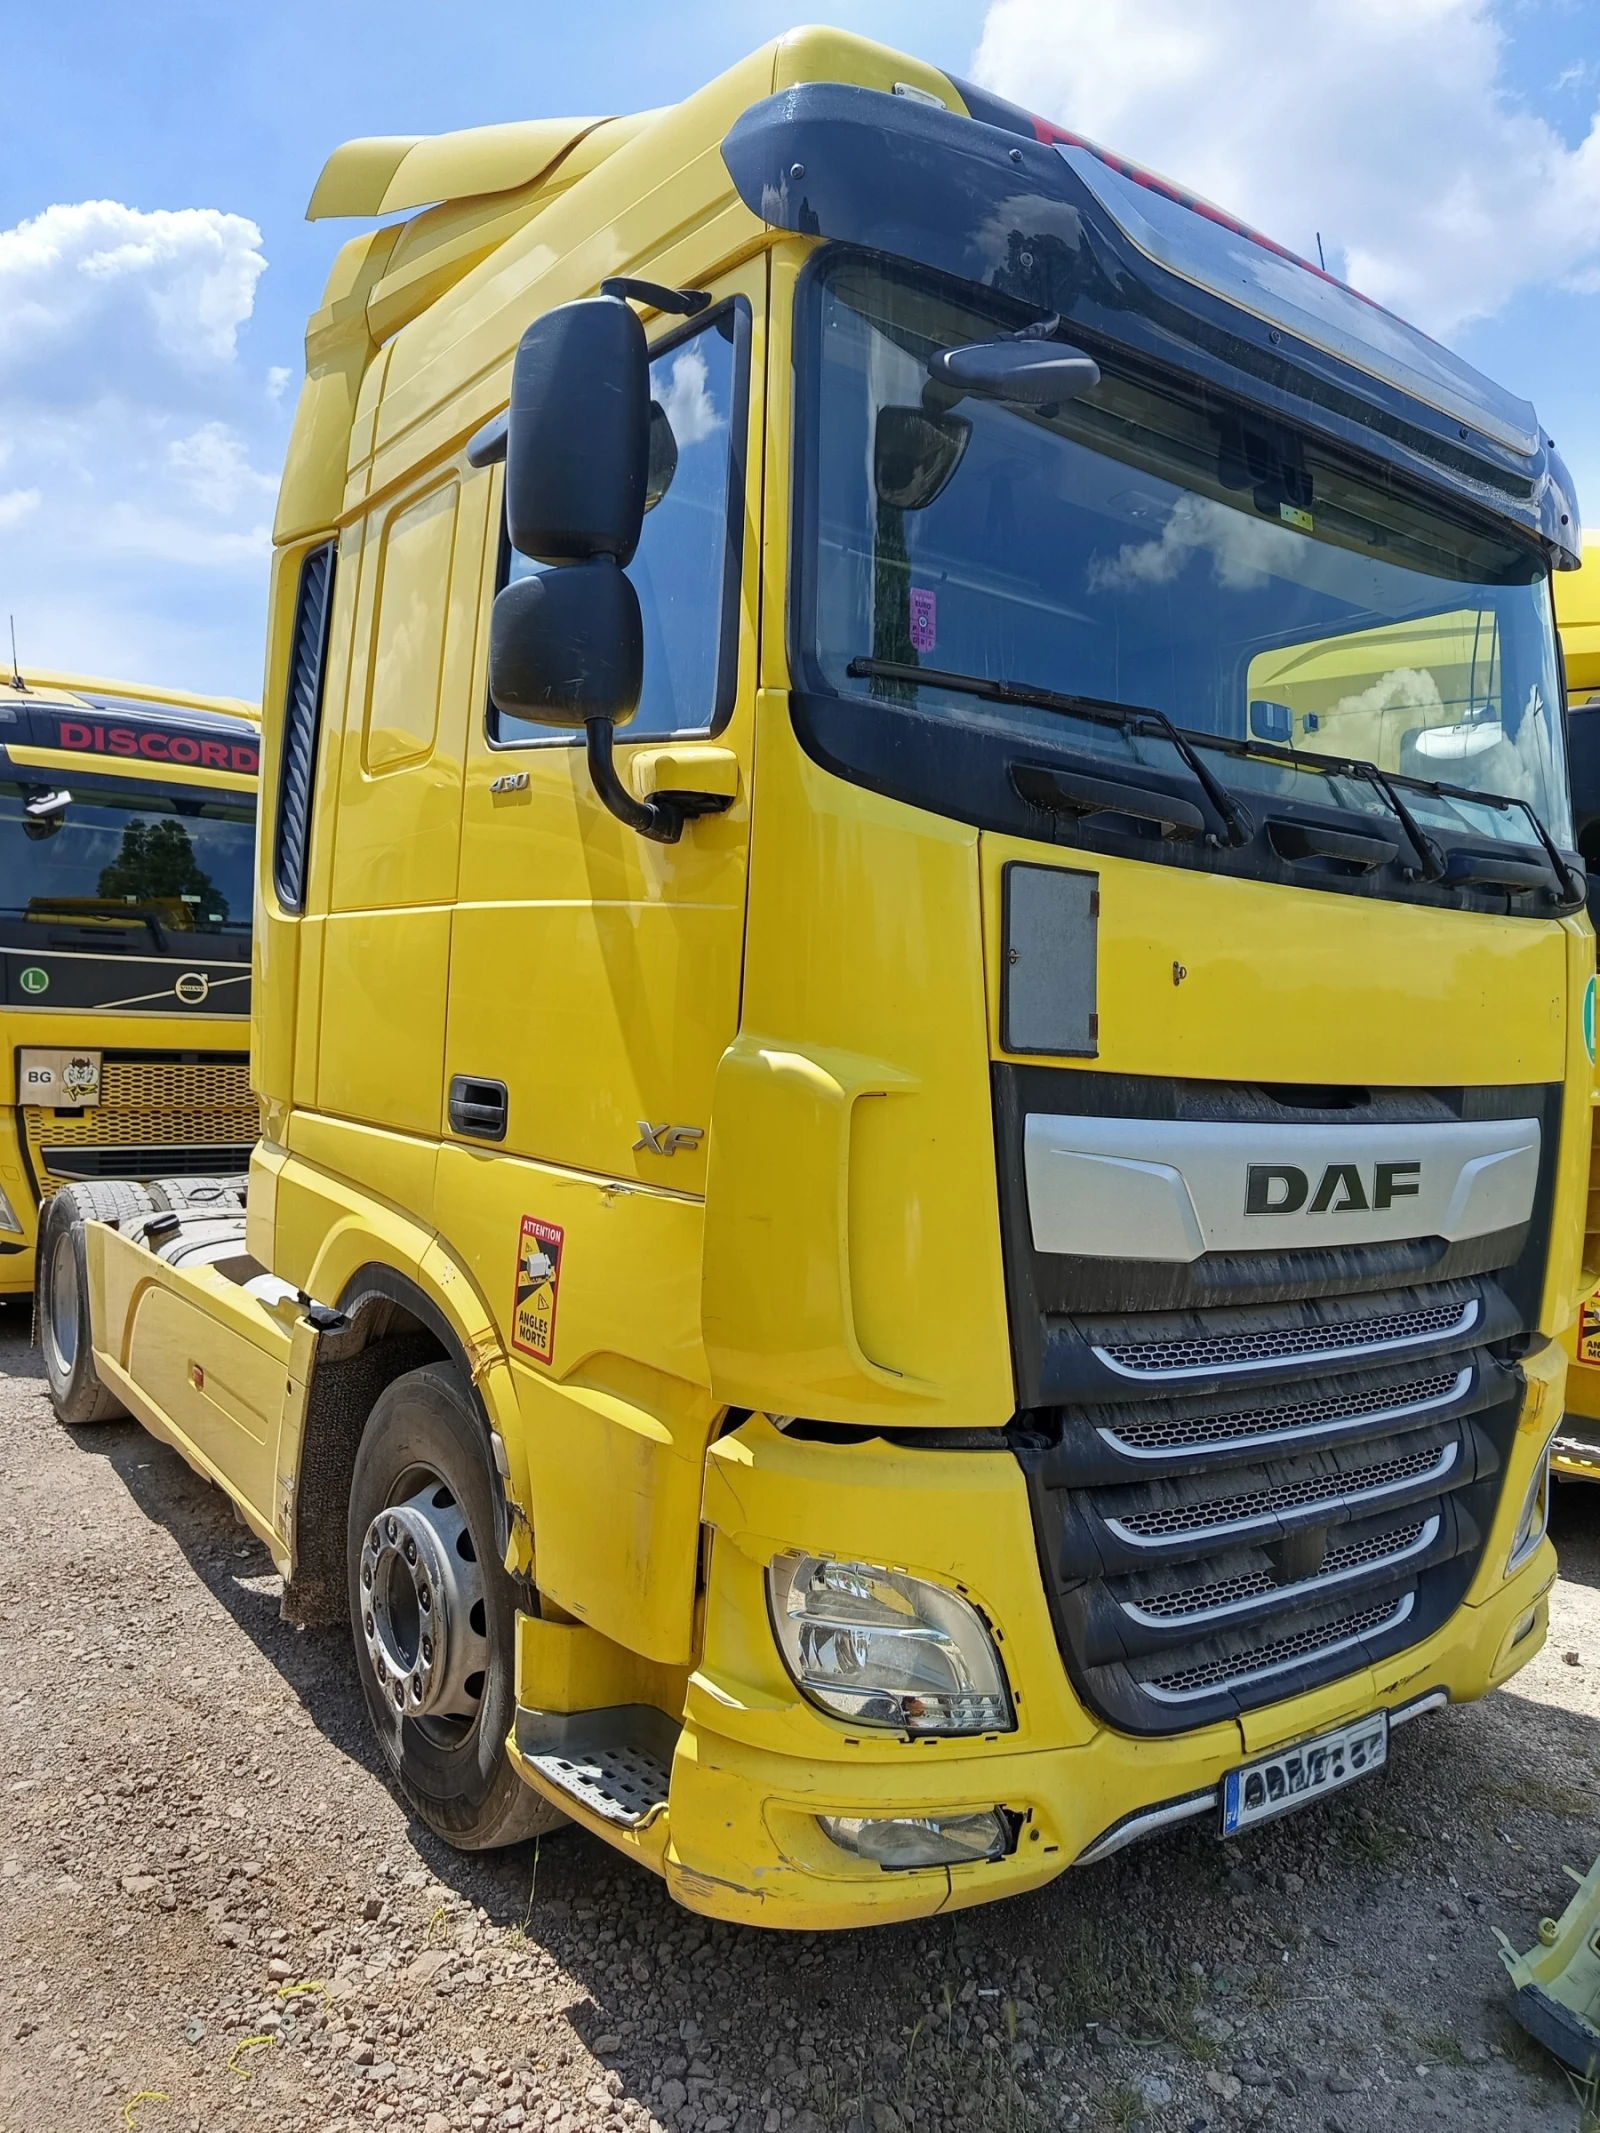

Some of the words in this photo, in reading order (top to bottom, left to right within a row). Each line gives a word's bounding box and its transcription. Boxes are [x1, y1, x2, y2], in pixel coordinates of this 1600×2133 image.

[60, 722, 260, 772] DISCORD
[28, 972, 41, 989] L
[28, 1071, 52, 1083] BG
[631, 1120, 704, 1156] XF
[1244, 1159, 1421, 1216] DAF
[522, 1219, 561, 1243] ATTENTION
[518, 1310, 548, 1335] ANGLES
[519, 1325, 546, 1349] MORTS
